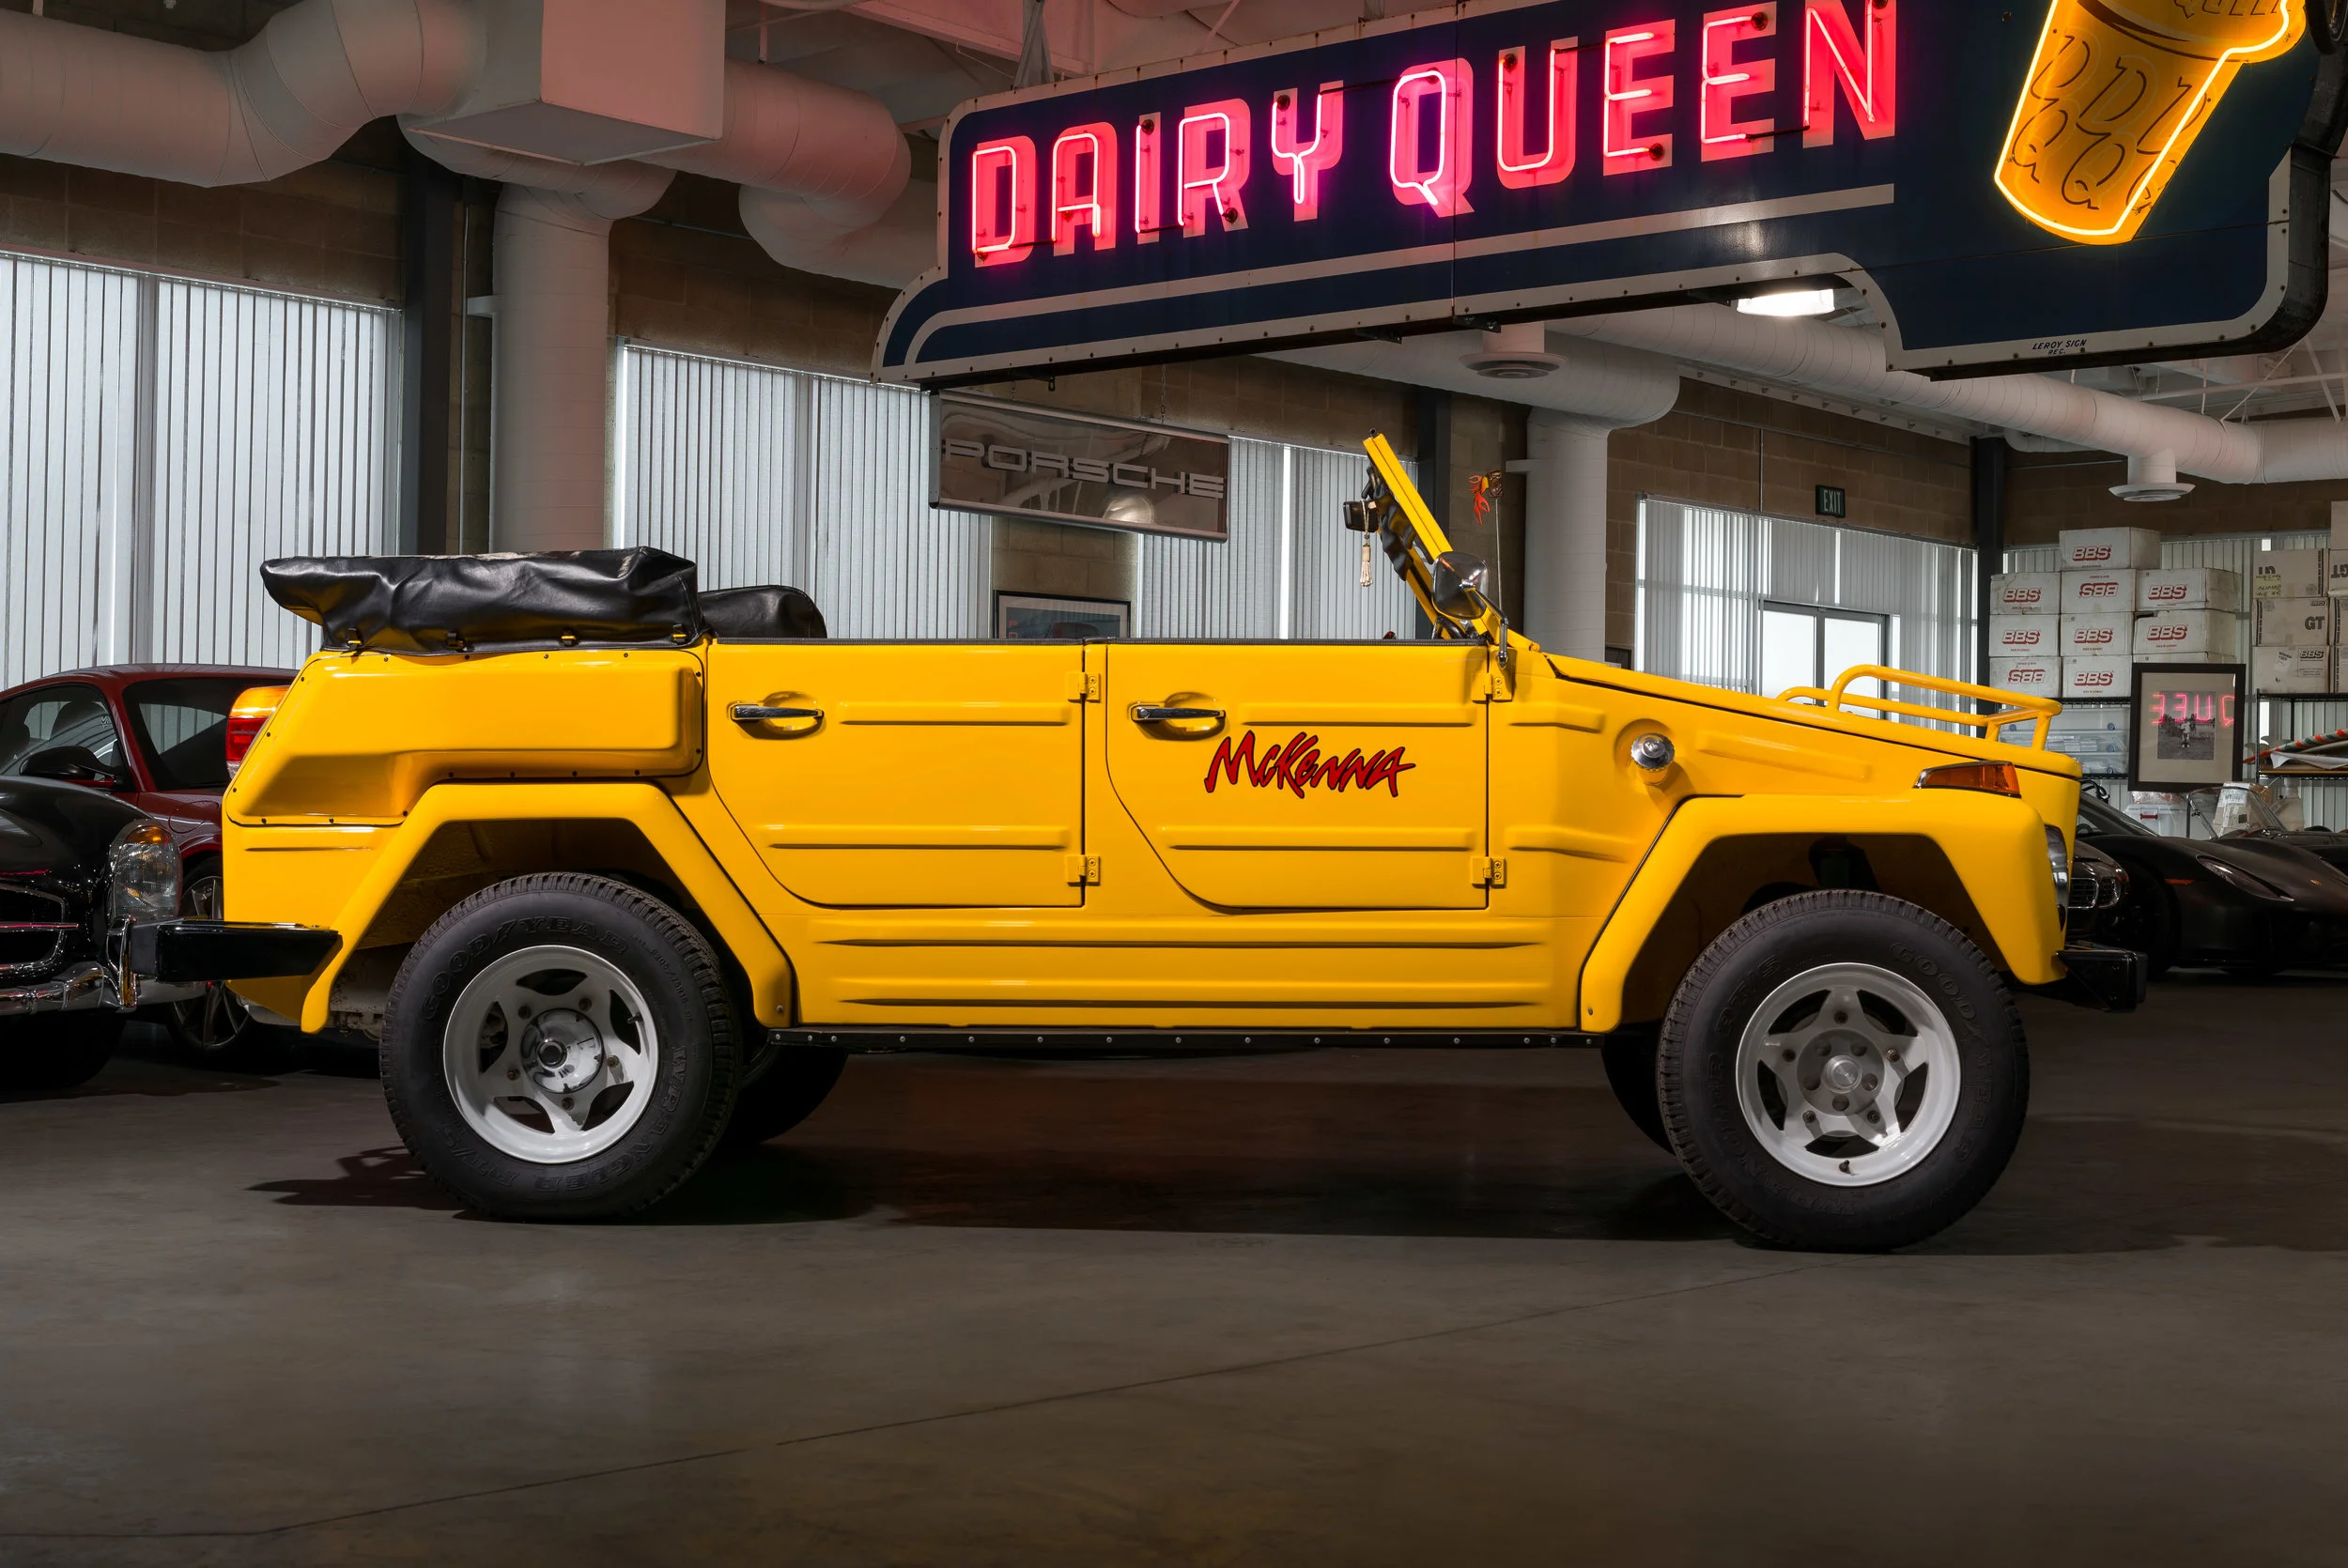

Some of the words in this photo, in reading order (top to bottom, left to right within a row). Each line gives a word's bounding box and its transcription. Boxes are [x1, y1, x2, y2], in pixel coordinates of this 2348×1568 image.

[972, 80, 1344, 268] DAIRY
[1389, 0, 1896, 218] QUEEN
[2031, 341, 2063, 350] LEROY
[2065, 339, 2087, 347] SIGN
[942, 438, 1225, 499] PORSCHE
[1823, 489, 1841, 514] EXIT
[2073, 546, 2111, 561] BBS
[2003, 588, 2041, 603] BBS
[2079, 582, 2119, 597] BBS
[2148, 584, 2187, 600] BBS
[2304, 616, 2325, 630] GT
[2002, 630, 2040, 644] BBS
[2074, 628, 2113, 643] BBS
[2147, 624, 2188, 640] BBS
[2300, 650, 2325, 659] BBS
[2008, 669, 2046, 684] BBS
[2074, 670, 2113, 685] BBS
[421, 915, 629, 1022] GOODYEAR
[1889, 941, 1995, 1164] GOODYEAR
